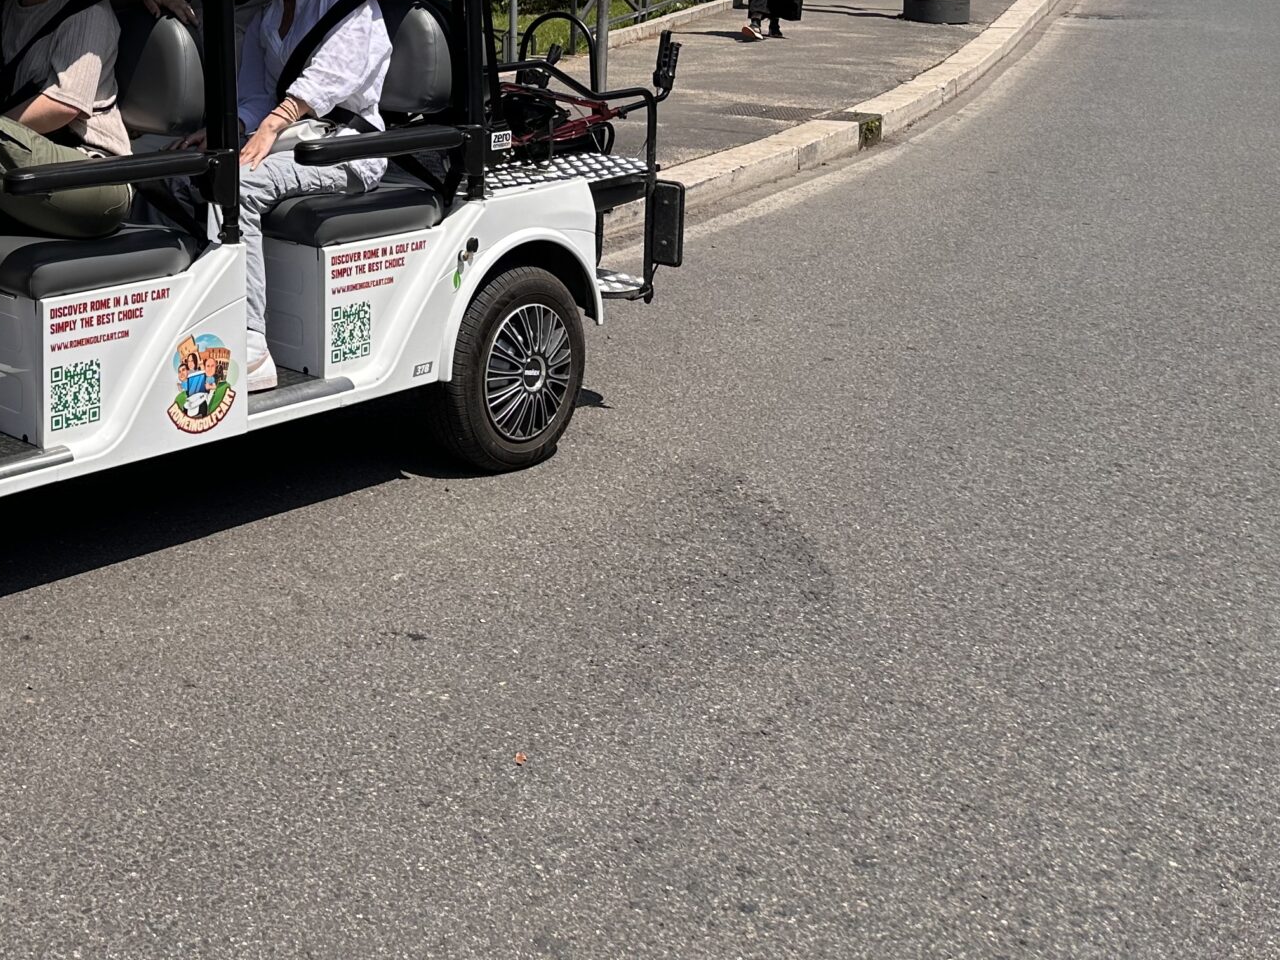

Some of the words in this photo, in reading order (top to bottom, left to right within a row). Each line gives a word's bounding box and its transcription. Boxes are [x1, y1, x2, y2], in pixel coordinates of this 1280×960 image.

[493, 132, 511, 143] zero
[331, 251, 362, 266] DISCOVER
[363, 248, 380, 260] ROME
[381, 247, 388, 257] IN
[389, 245, 394, 256] A
[395, 243, 410, 254] GOLF
[411, 240, 427, 252] CART
[331, 266, 353, 279] SIMPLY
[355, 264, 366, 275] THE
[367, 261, 383, 273] BEST
[384, 257, 405, 270] CHOICE
[50, 303, 88, 320] DISCOVER
[90, 297, 111, 311] ROME
[113, 296, 121, 307] IN
[123, 294, 129, 306] A
[131, 291, 149, 305] GOLF
[151, 288, 171, 300] CART
[50, 319, 77, 335] SIMPLY
[80, 316, 94, 329] THE
[96, 311, 116, 326] BEST
[117, 307, 144, 321] CHOICE
[50, 329, 130, 353] WWW.ROMEINGOLFCART.COM
[169, 390, 235, 432] ROMEINGOLFCART
